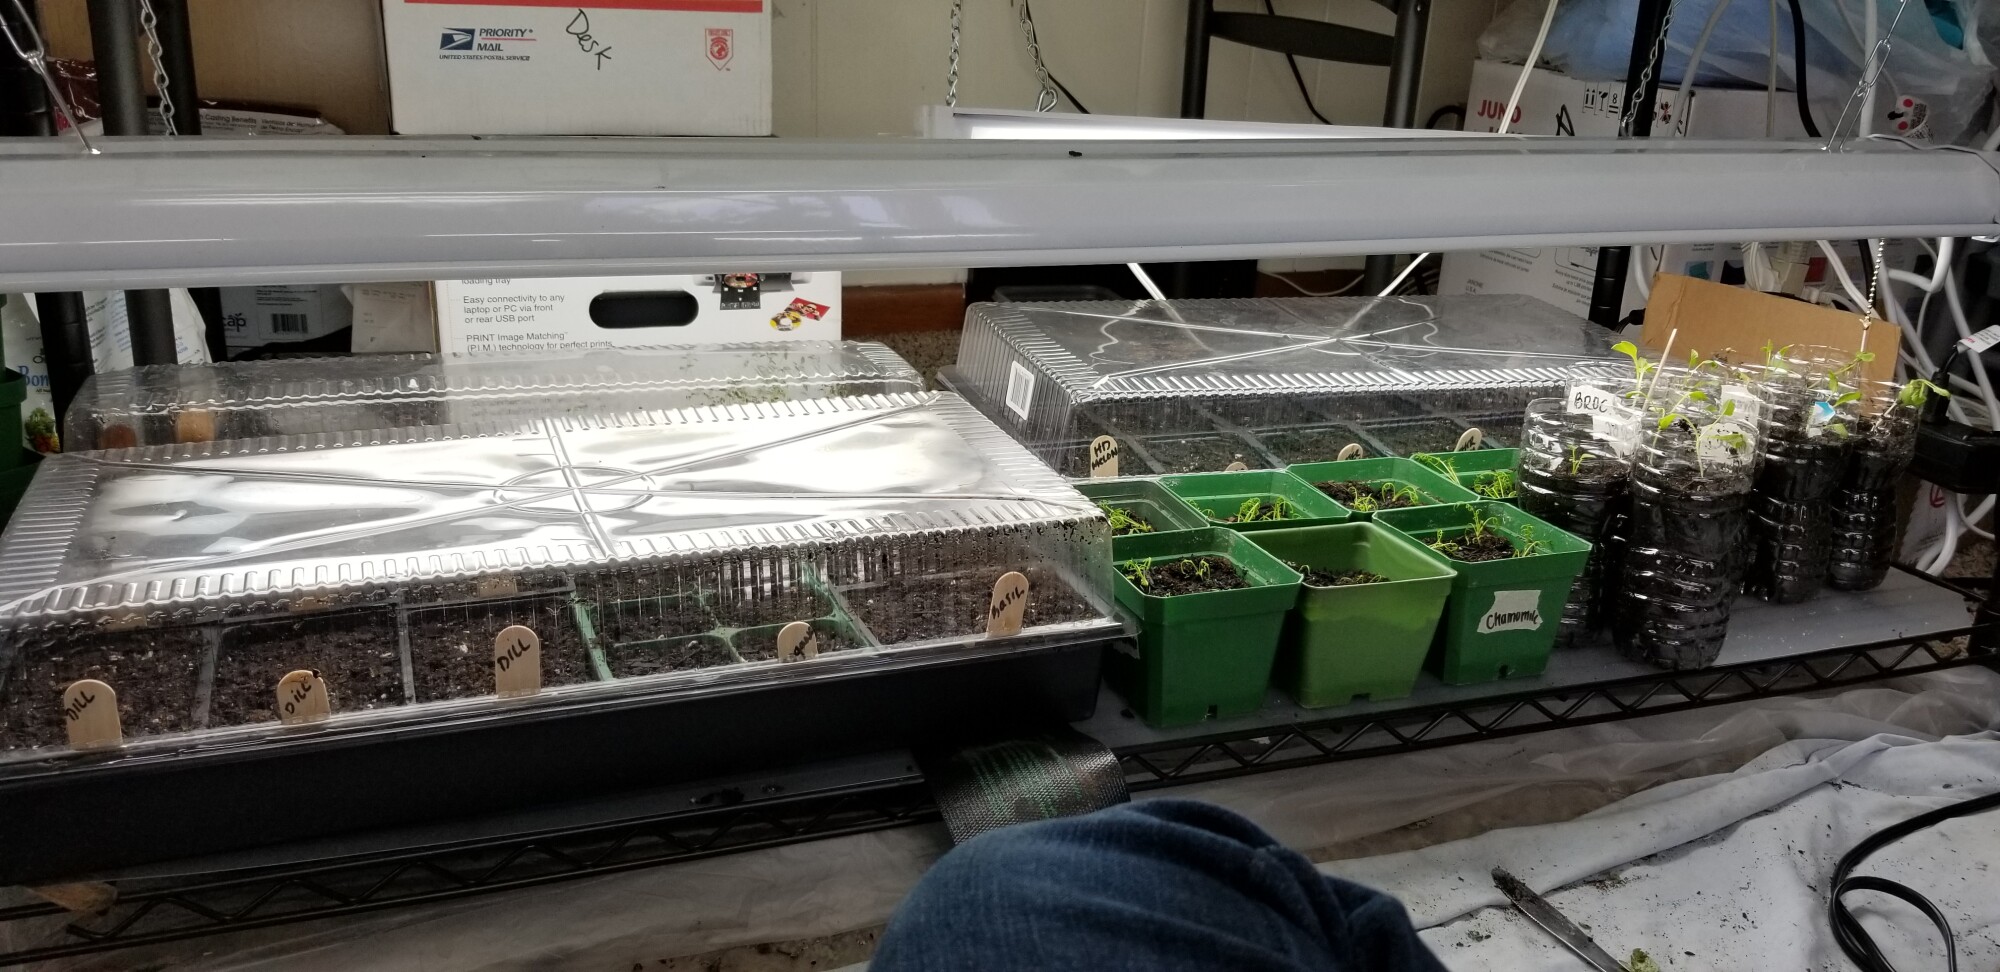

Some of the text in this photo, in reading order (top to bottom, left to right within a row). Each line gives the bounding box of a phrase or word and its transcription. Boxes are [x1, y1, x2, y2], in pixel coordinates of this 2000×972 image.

[566, 8, 612, 70] Desk
[477, 43, 503, 51] MAIL
[463, 296, 485, 304] Easy
[487, 295, 537, 303] connectivity
[464, 306, 490, 314] laptop
[518, 315, 535, 323] port
[466, 334, 495, 342] PRINT
[498, 333, 524, 342] Image
[560, 341, 588, 349] perfect
[1574, 391, 1608, 413] BROC
